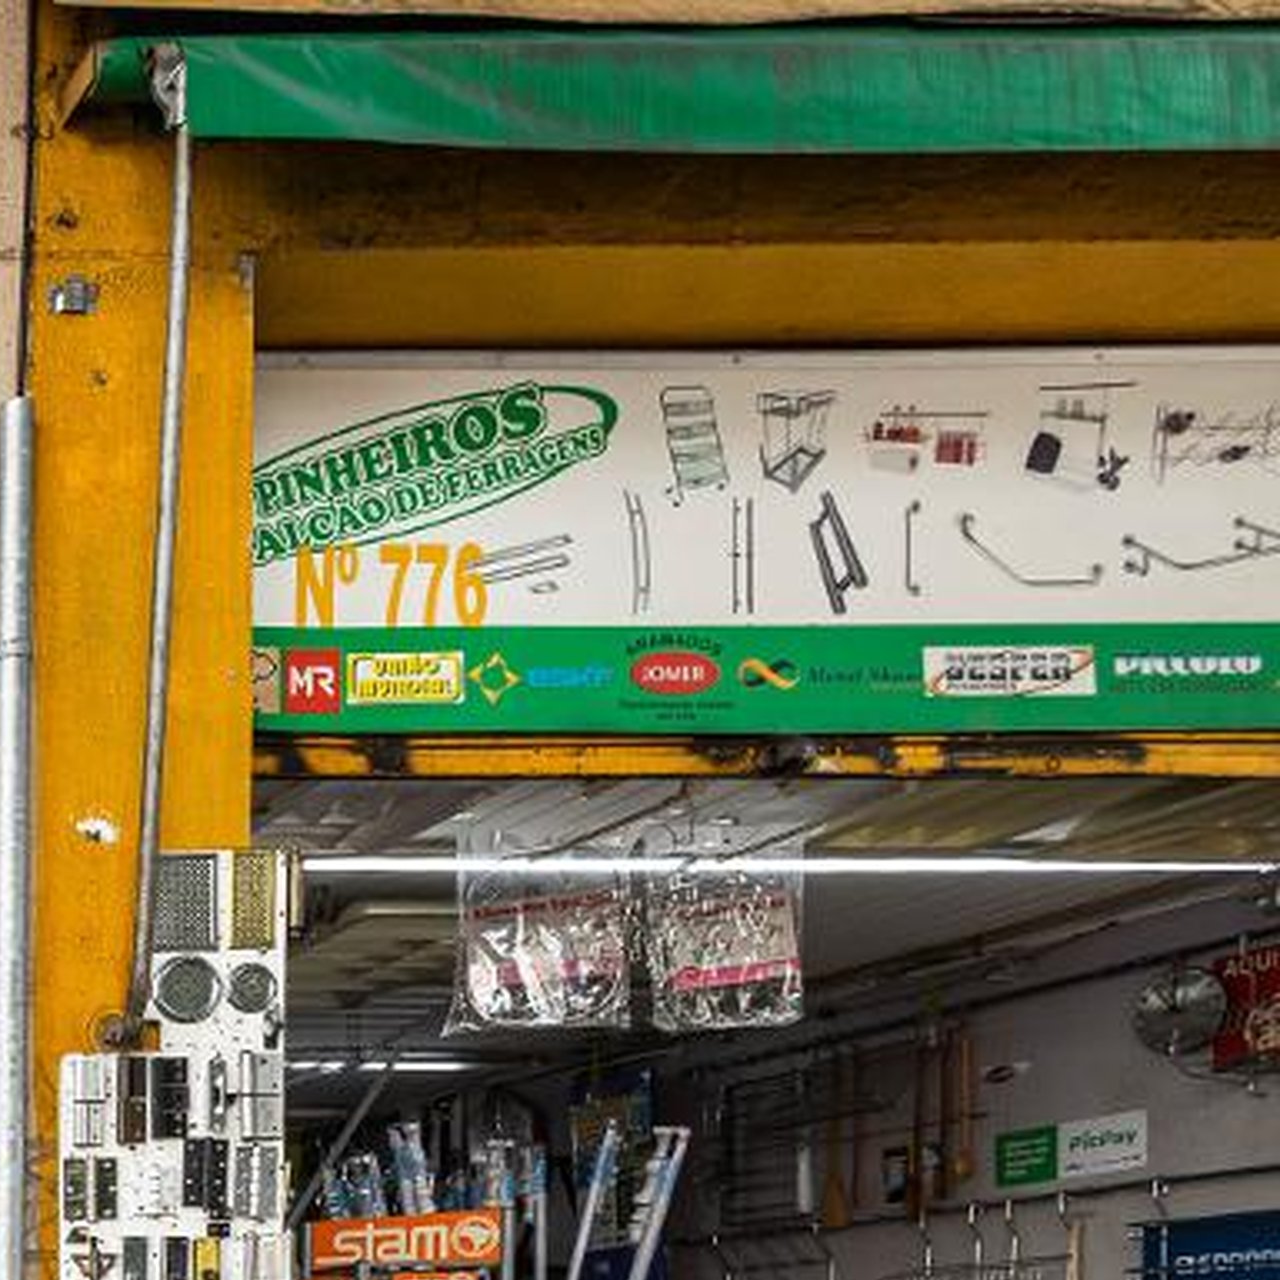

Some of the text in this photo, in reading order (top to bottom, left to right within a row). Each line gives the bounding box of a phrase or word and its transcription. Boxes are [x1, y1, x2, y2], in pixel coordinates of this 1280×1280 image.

[255, 389, 543, 513] PINHEIROS
[393, 478, 441, 514] DE
[444, 427, 603, 498] FERRAGENS
[379, 541, 488, 627] 776
[316, 1222, 449, 1265] stam
